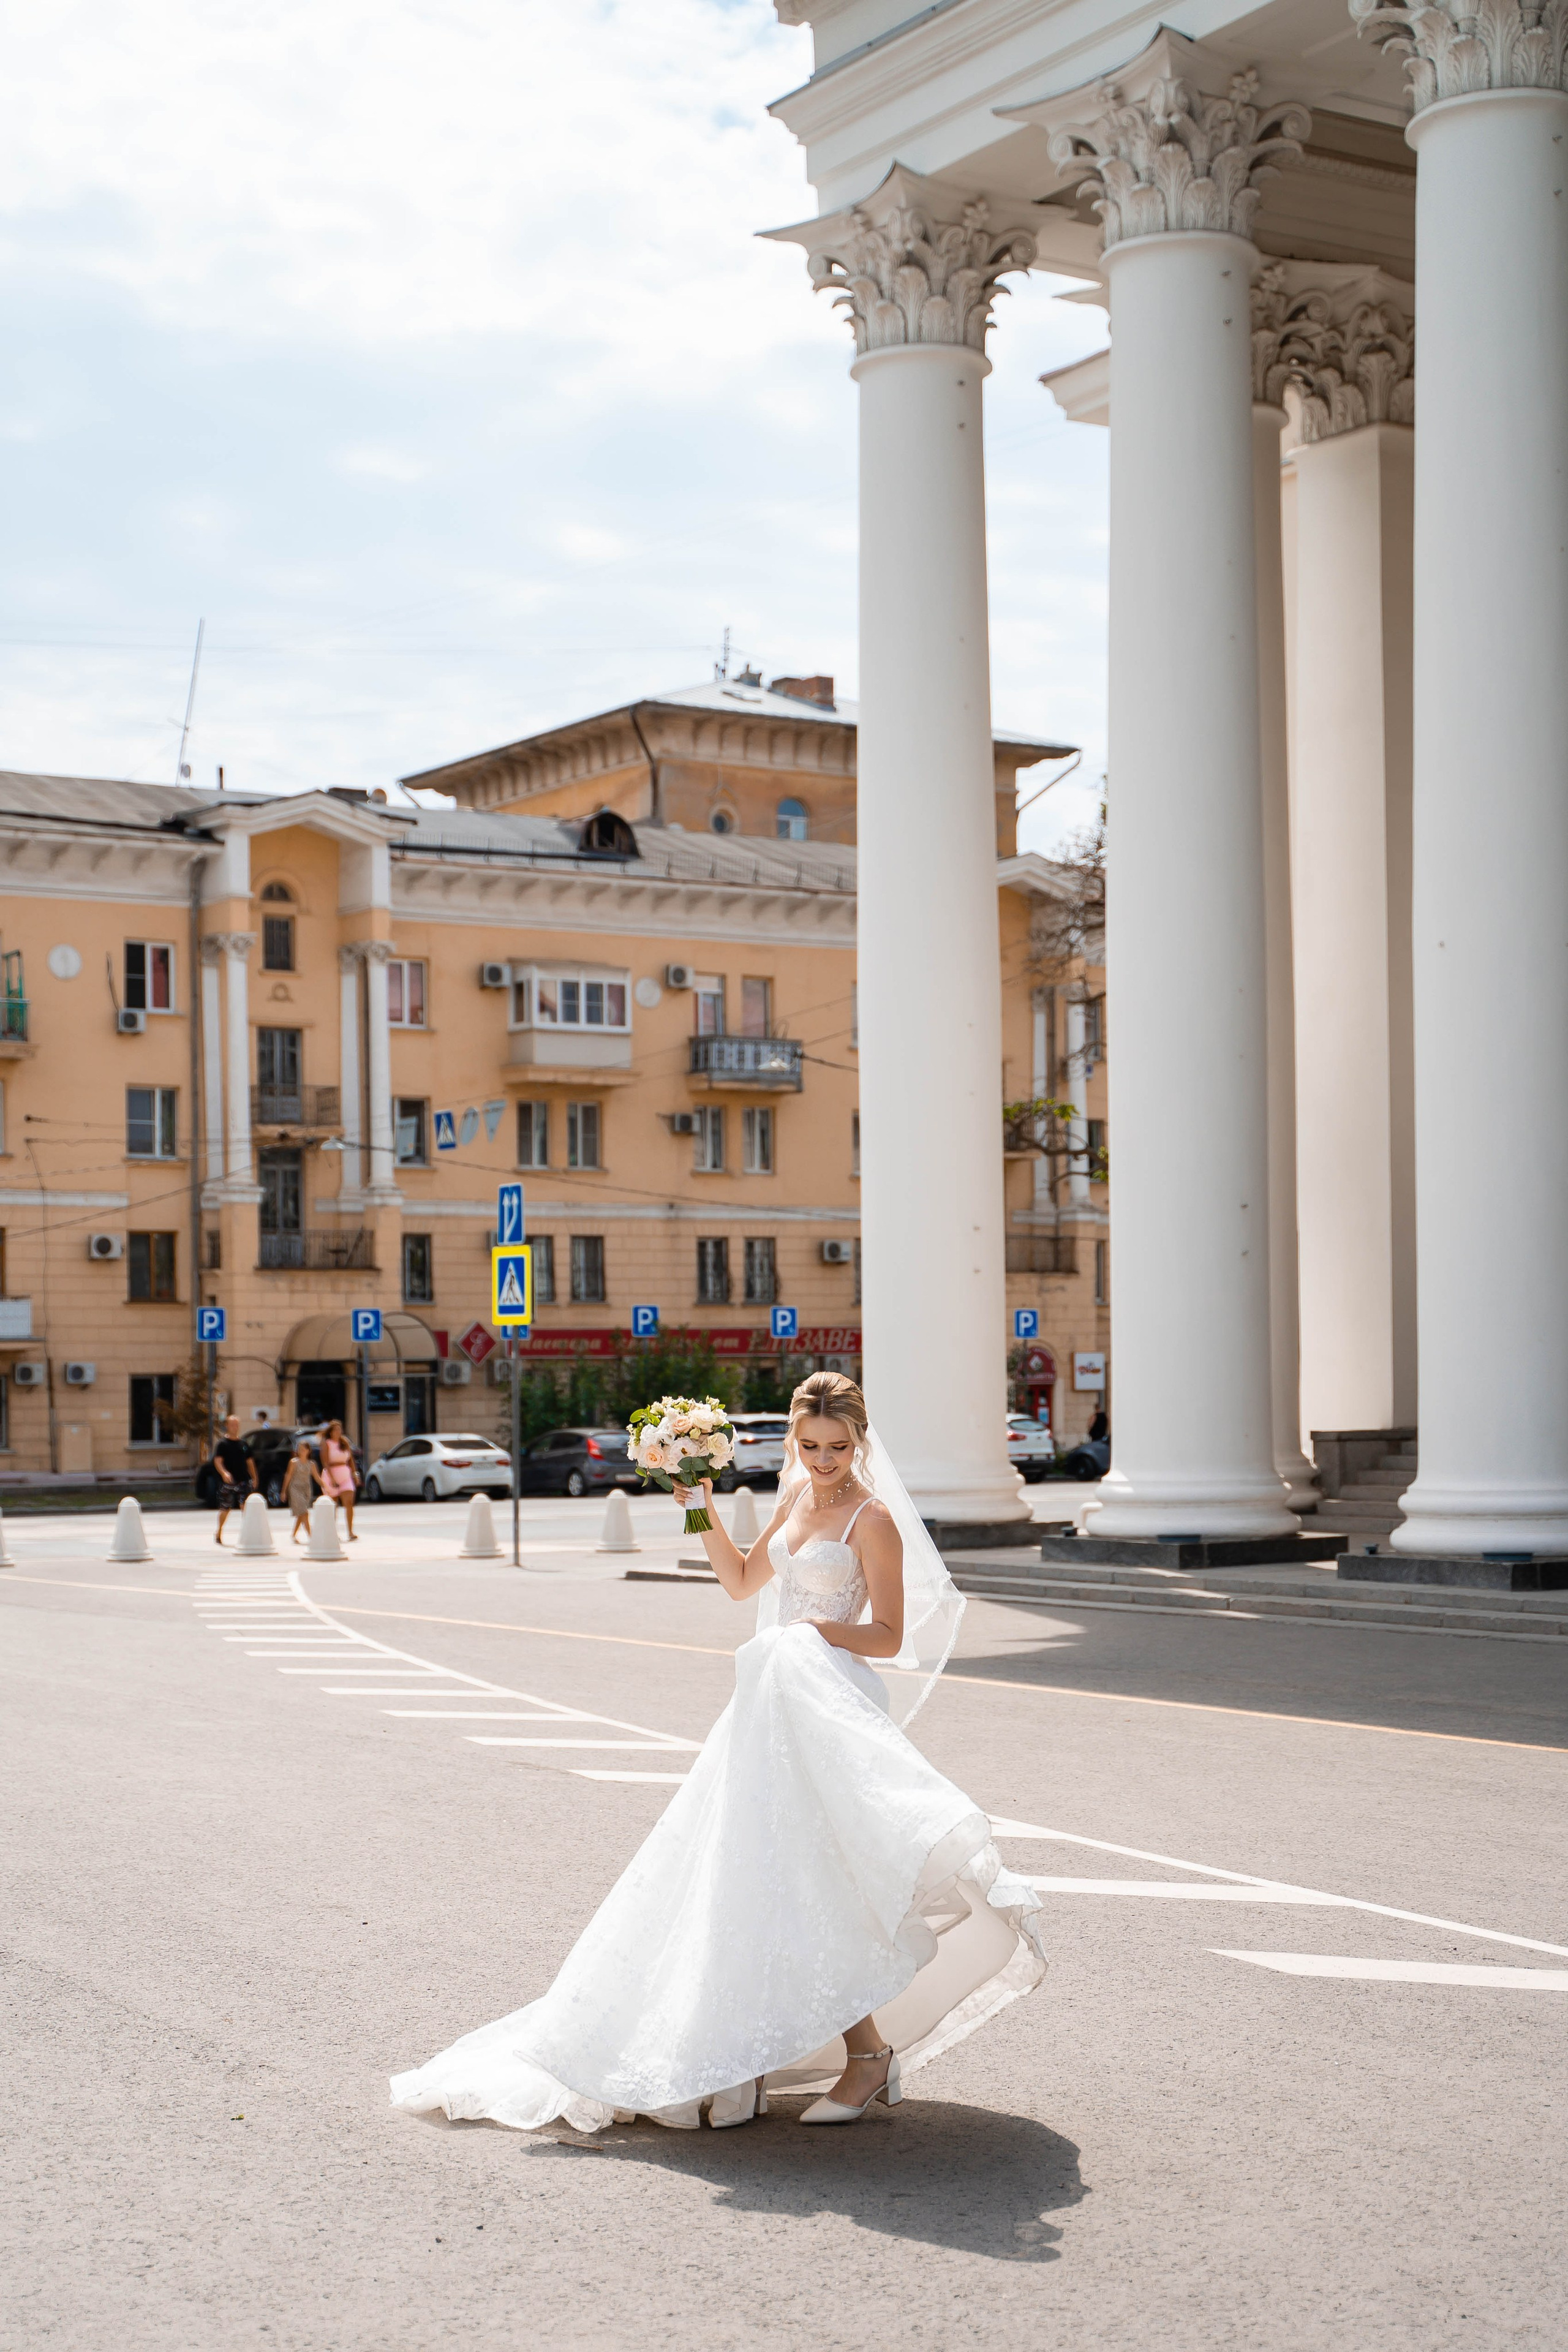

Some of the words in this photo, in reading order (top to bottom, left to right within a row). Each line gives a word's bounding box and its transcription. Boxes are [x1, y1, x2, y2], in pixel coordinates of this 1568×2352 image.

[203, 1311, 219, 1338] P
[358, 1311, 375, 1338] P
[638, 1308, 654, 1333] P
[776, 1310, 793, 1334] P
[1019, 1312, 1034, 1335] P
